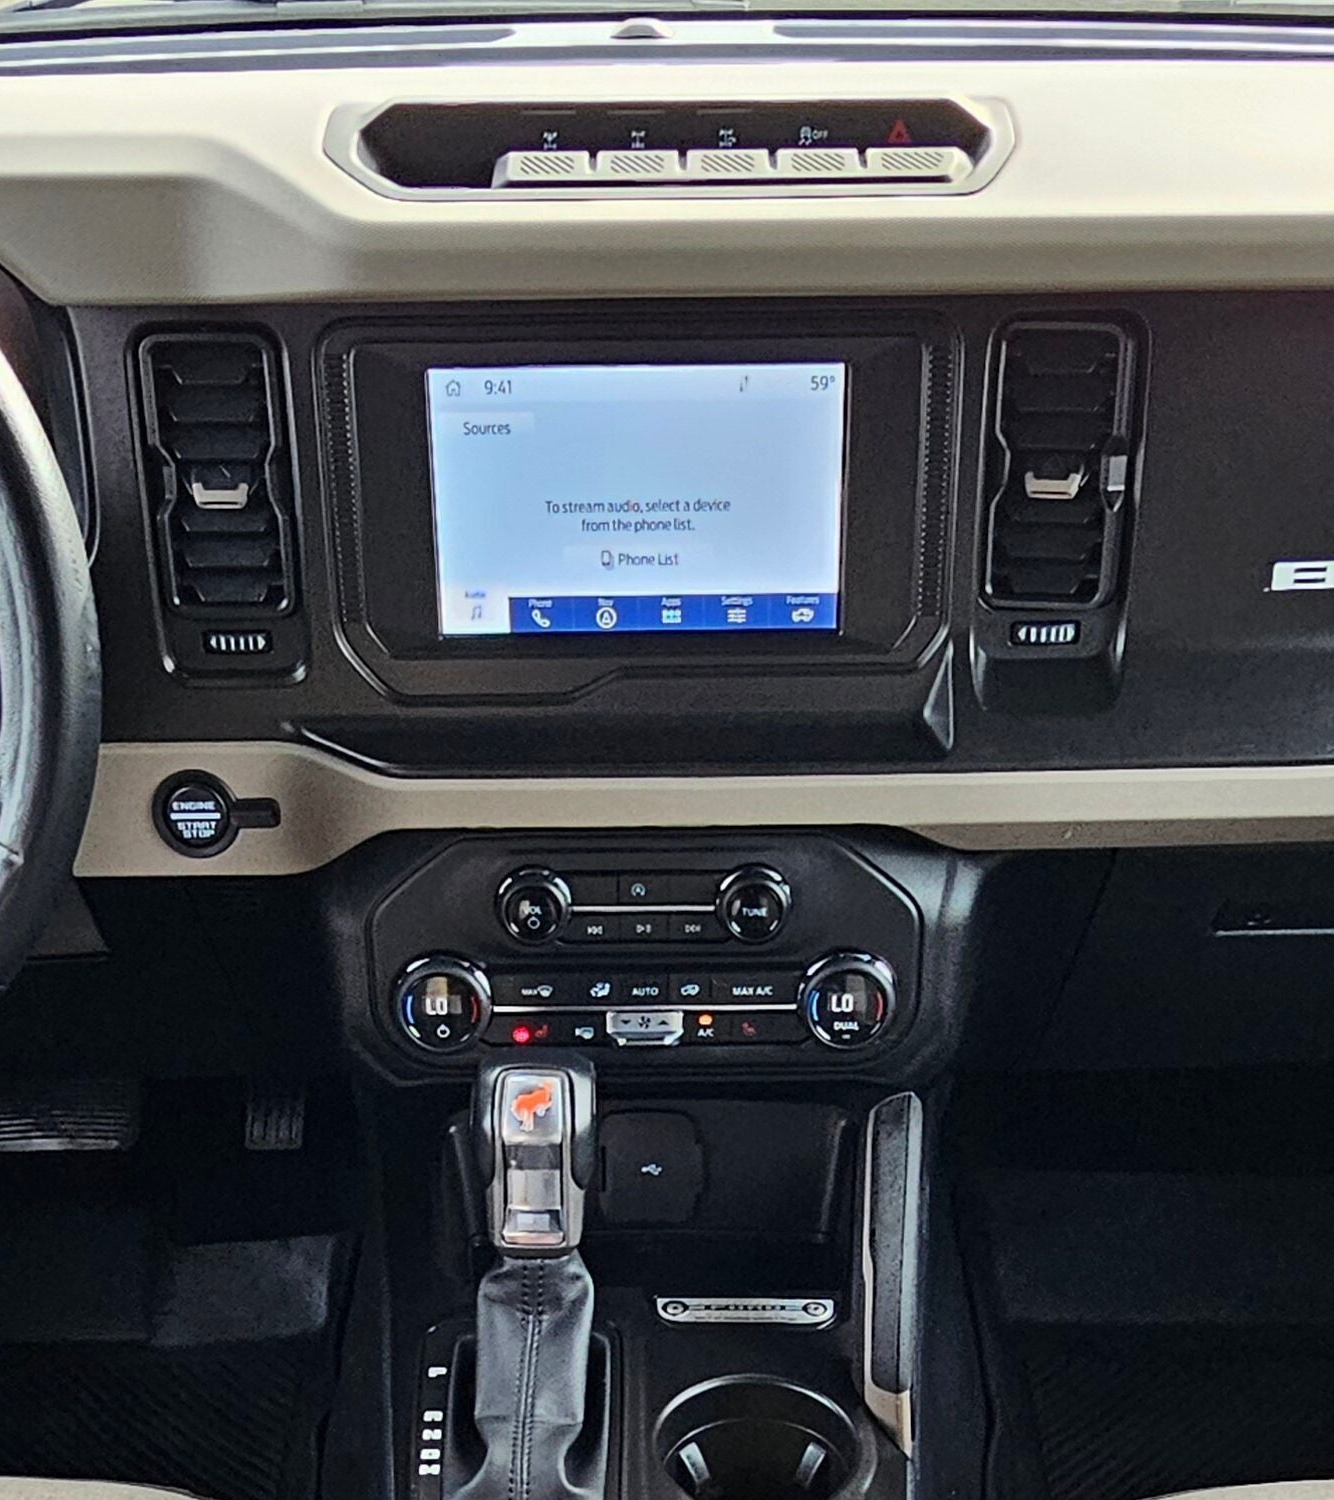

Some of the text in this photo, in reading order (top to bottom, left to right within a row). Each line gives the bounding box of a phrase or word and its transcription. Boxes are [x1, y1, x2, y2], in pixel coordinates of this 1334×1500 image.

[484, 379, 512, 395] 9:41
[463, 421, 512, 436] Sources
[545, 499, 732, 514] To stream audio, select a device
[581, 518, 697, 533] from the phone list.
[618, 552, 679, 566] Phone List
[528, 599, 553, 609] Phone
[721, 596, 754, 607] Settings
[786, 595, 819, 605] Features
[172, 801, 216, 811] ENGINE
[177, 821, 217, 831] START
[182, 829, 216, 839] STOP
[632, 986, 659, 997] AUTO
[733, 986, 774, 997] MAX A/C
[425, 996, 448, 1015] LO
[831, 993, 854, 1013] LO
[833, 1021, 860, 1031] DUAL
[698, 1028, 714, 1037] A/C
